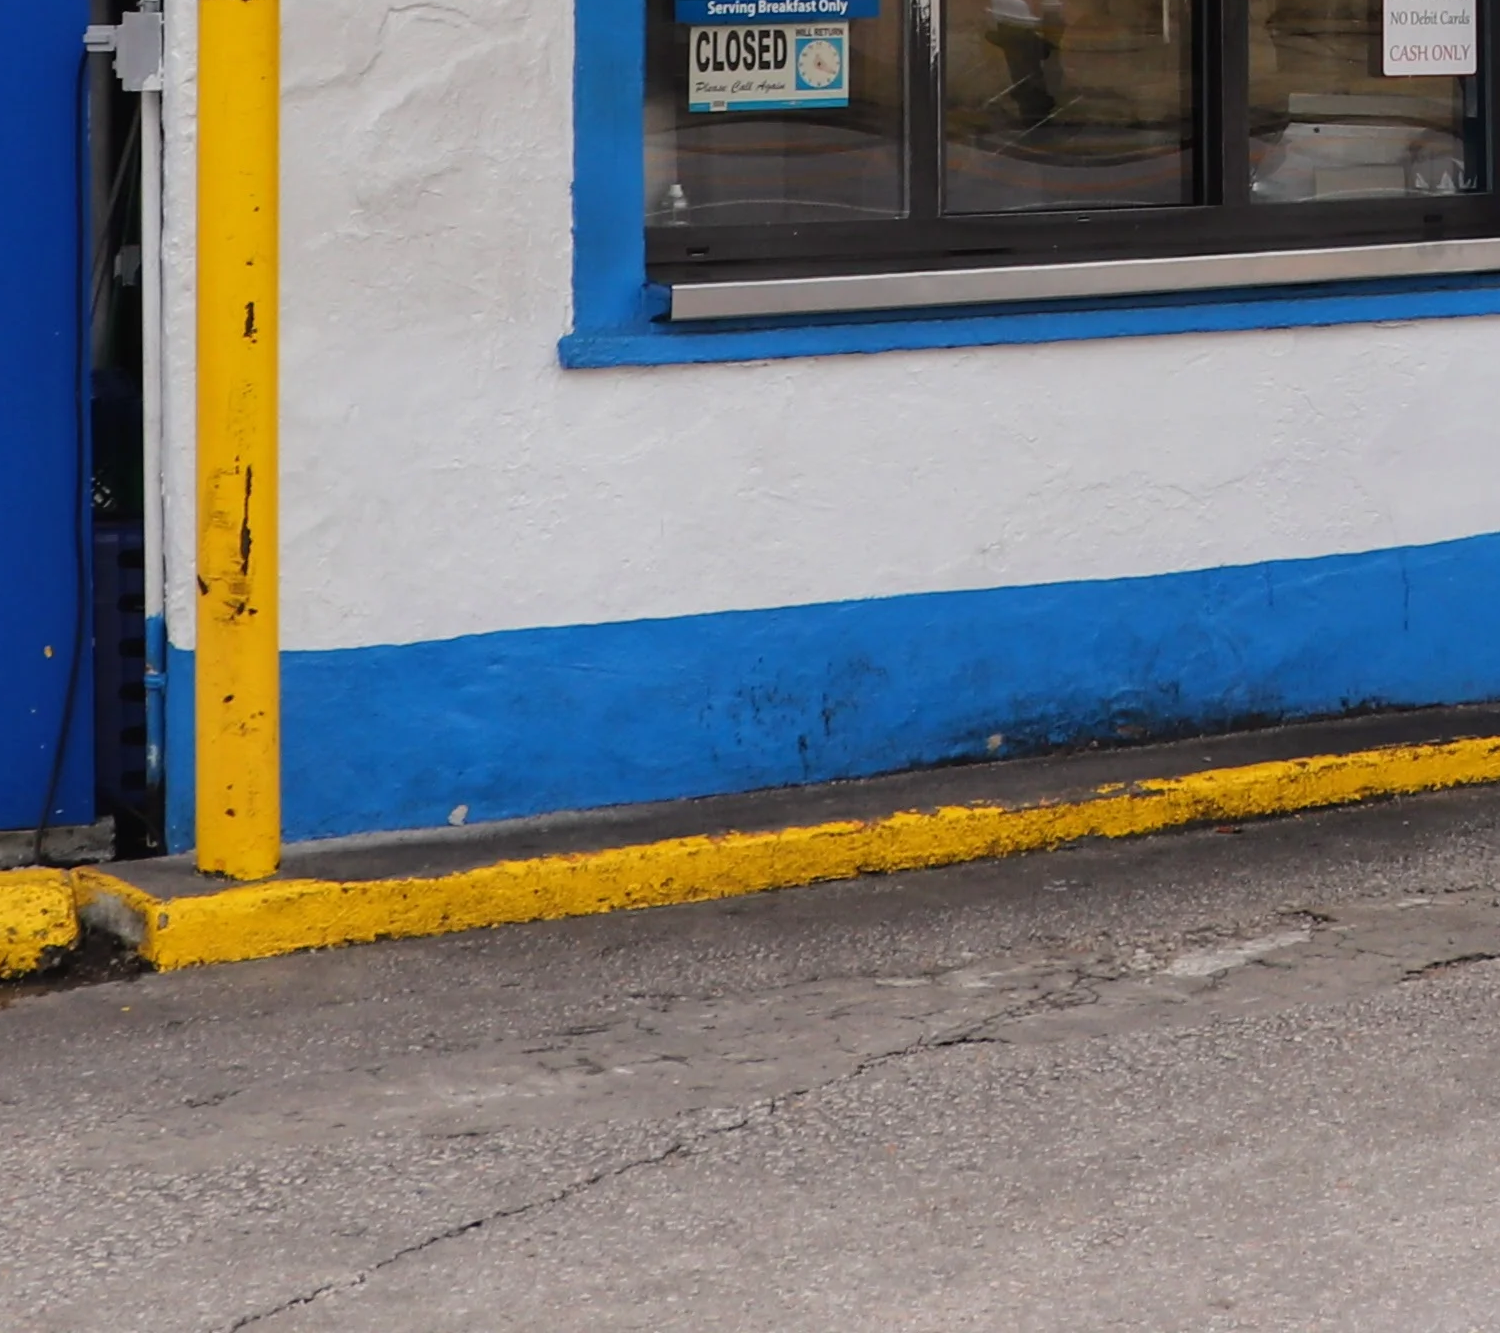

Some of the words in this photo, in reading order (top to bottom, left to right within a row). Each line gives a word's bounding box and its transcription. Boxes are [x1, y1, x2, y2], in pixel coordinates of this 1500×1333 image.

[707, 0, 755, 17] Serving
[1390, 11, 1408, 25] NO
[1410, 10, 1437, 25] Debit
[1440, 9, 1470, 25] Cards
[696, 29, 787, 73] CLOSED
[814, 28, 844, 36] RETURN
[1390, 44, 1428, 61] CASH
[1431, 43, 1471, 61] ONLY
[695, 82, 727, 93] Please
[731, 80, 753, 93] Call
[755, 79, 786, 93] Again
